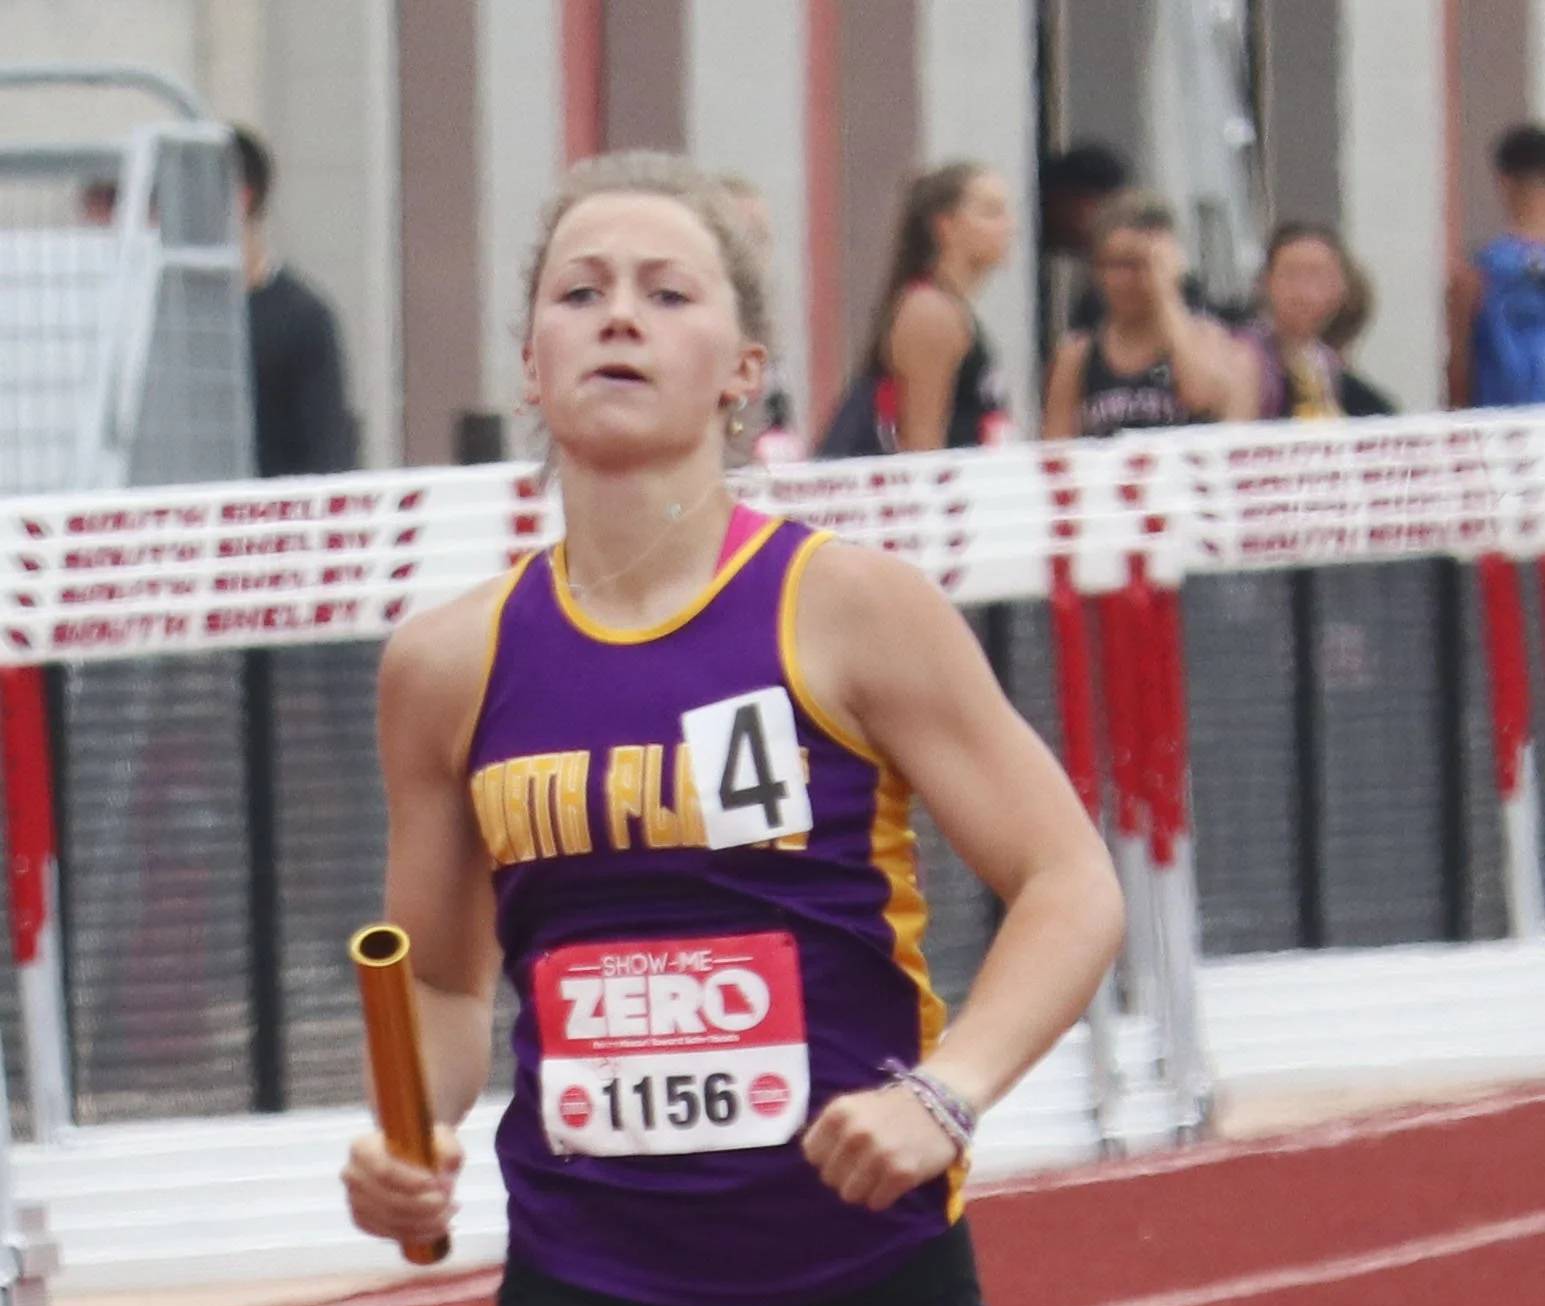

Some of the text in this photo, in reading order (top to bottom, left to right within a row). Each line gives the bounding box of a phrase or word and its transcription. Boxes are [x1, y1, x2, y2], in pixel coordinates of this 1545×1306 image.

[720, 702, 789, 829] 4
[602, 950, 714, 977] SHOW-ME
[559, 967, 771, 1041] ZERO
[602, 1072, 740, 1132] 1156
